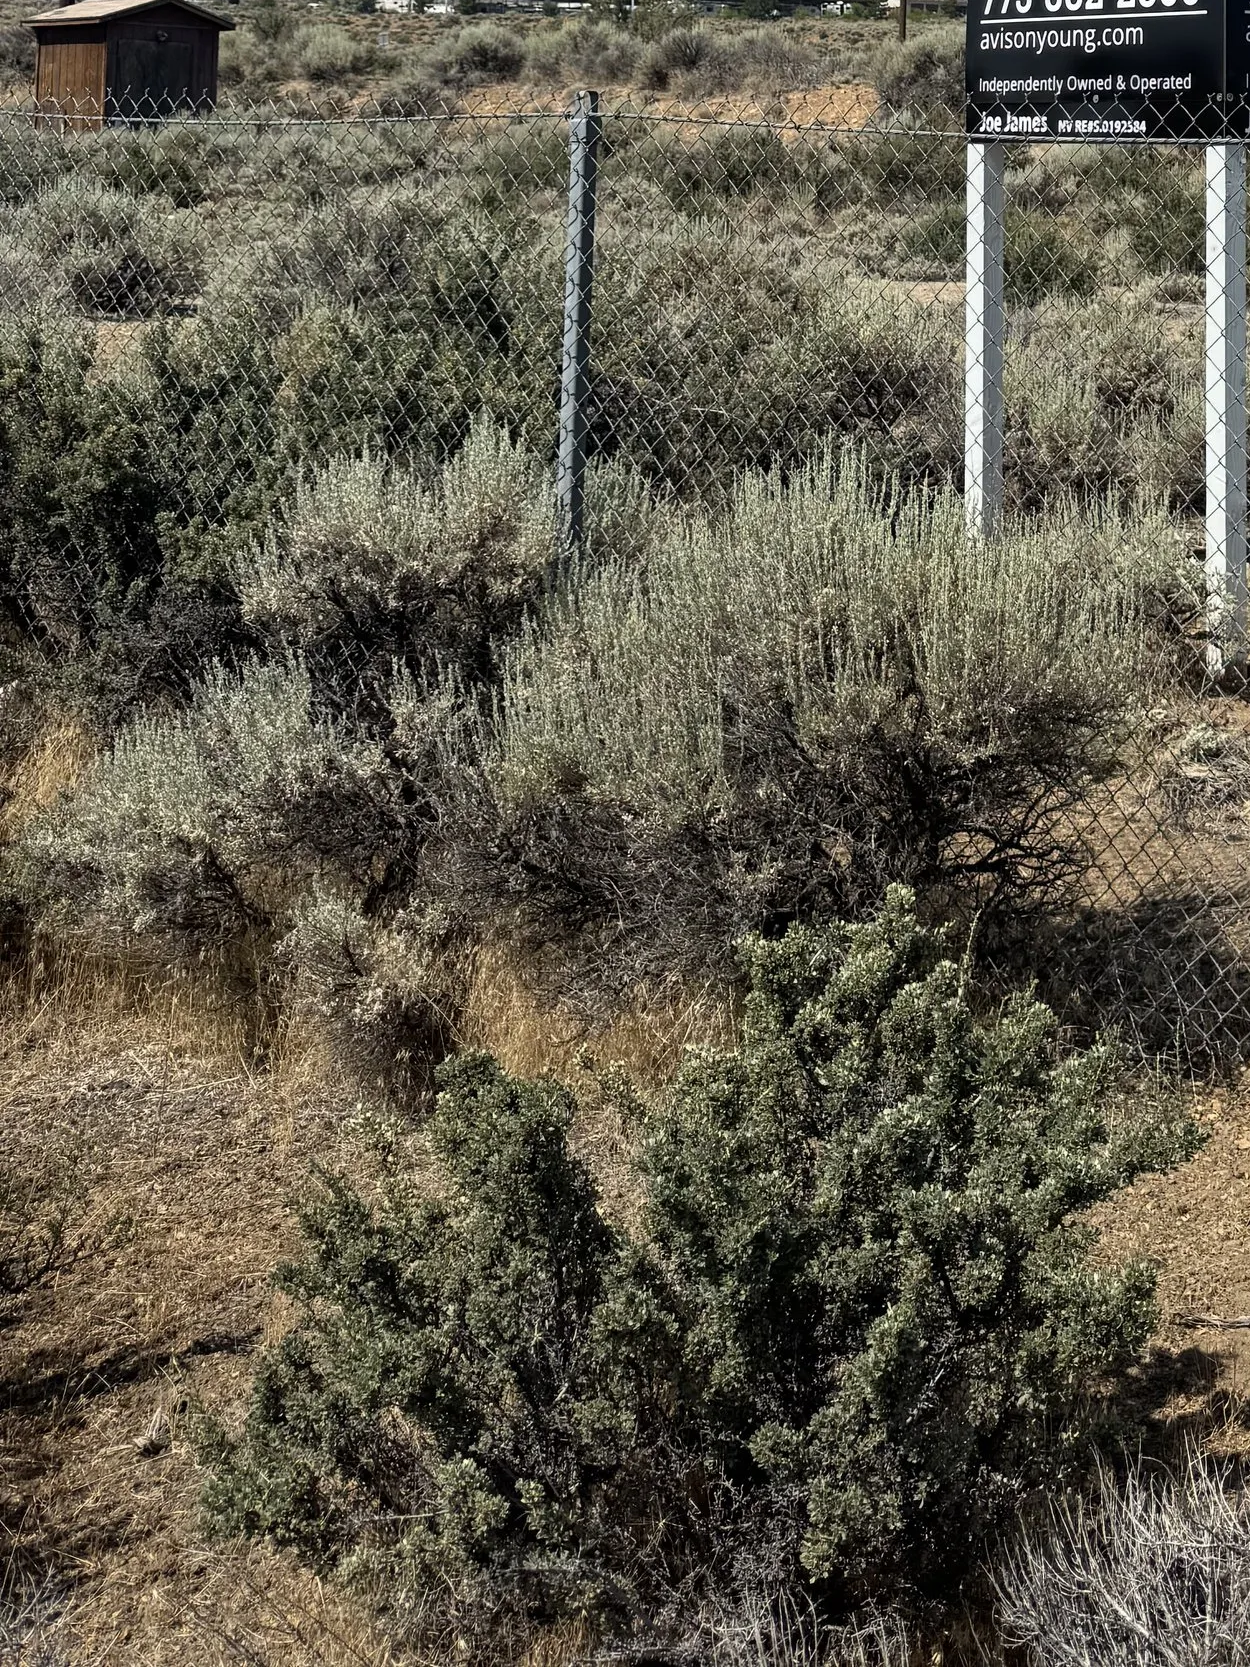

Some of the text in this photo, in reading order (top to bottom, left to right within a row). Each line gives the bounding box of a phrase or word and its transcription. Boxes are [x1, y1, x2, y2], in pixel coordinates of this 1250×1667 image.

[980, 26, 1144, 55] avisonyoung.com
[979, 73, 1192, 95] Independently Owned & Operated
[979, 111, 1001, 133] Joe
[1004, 111, 1048, 133] James
